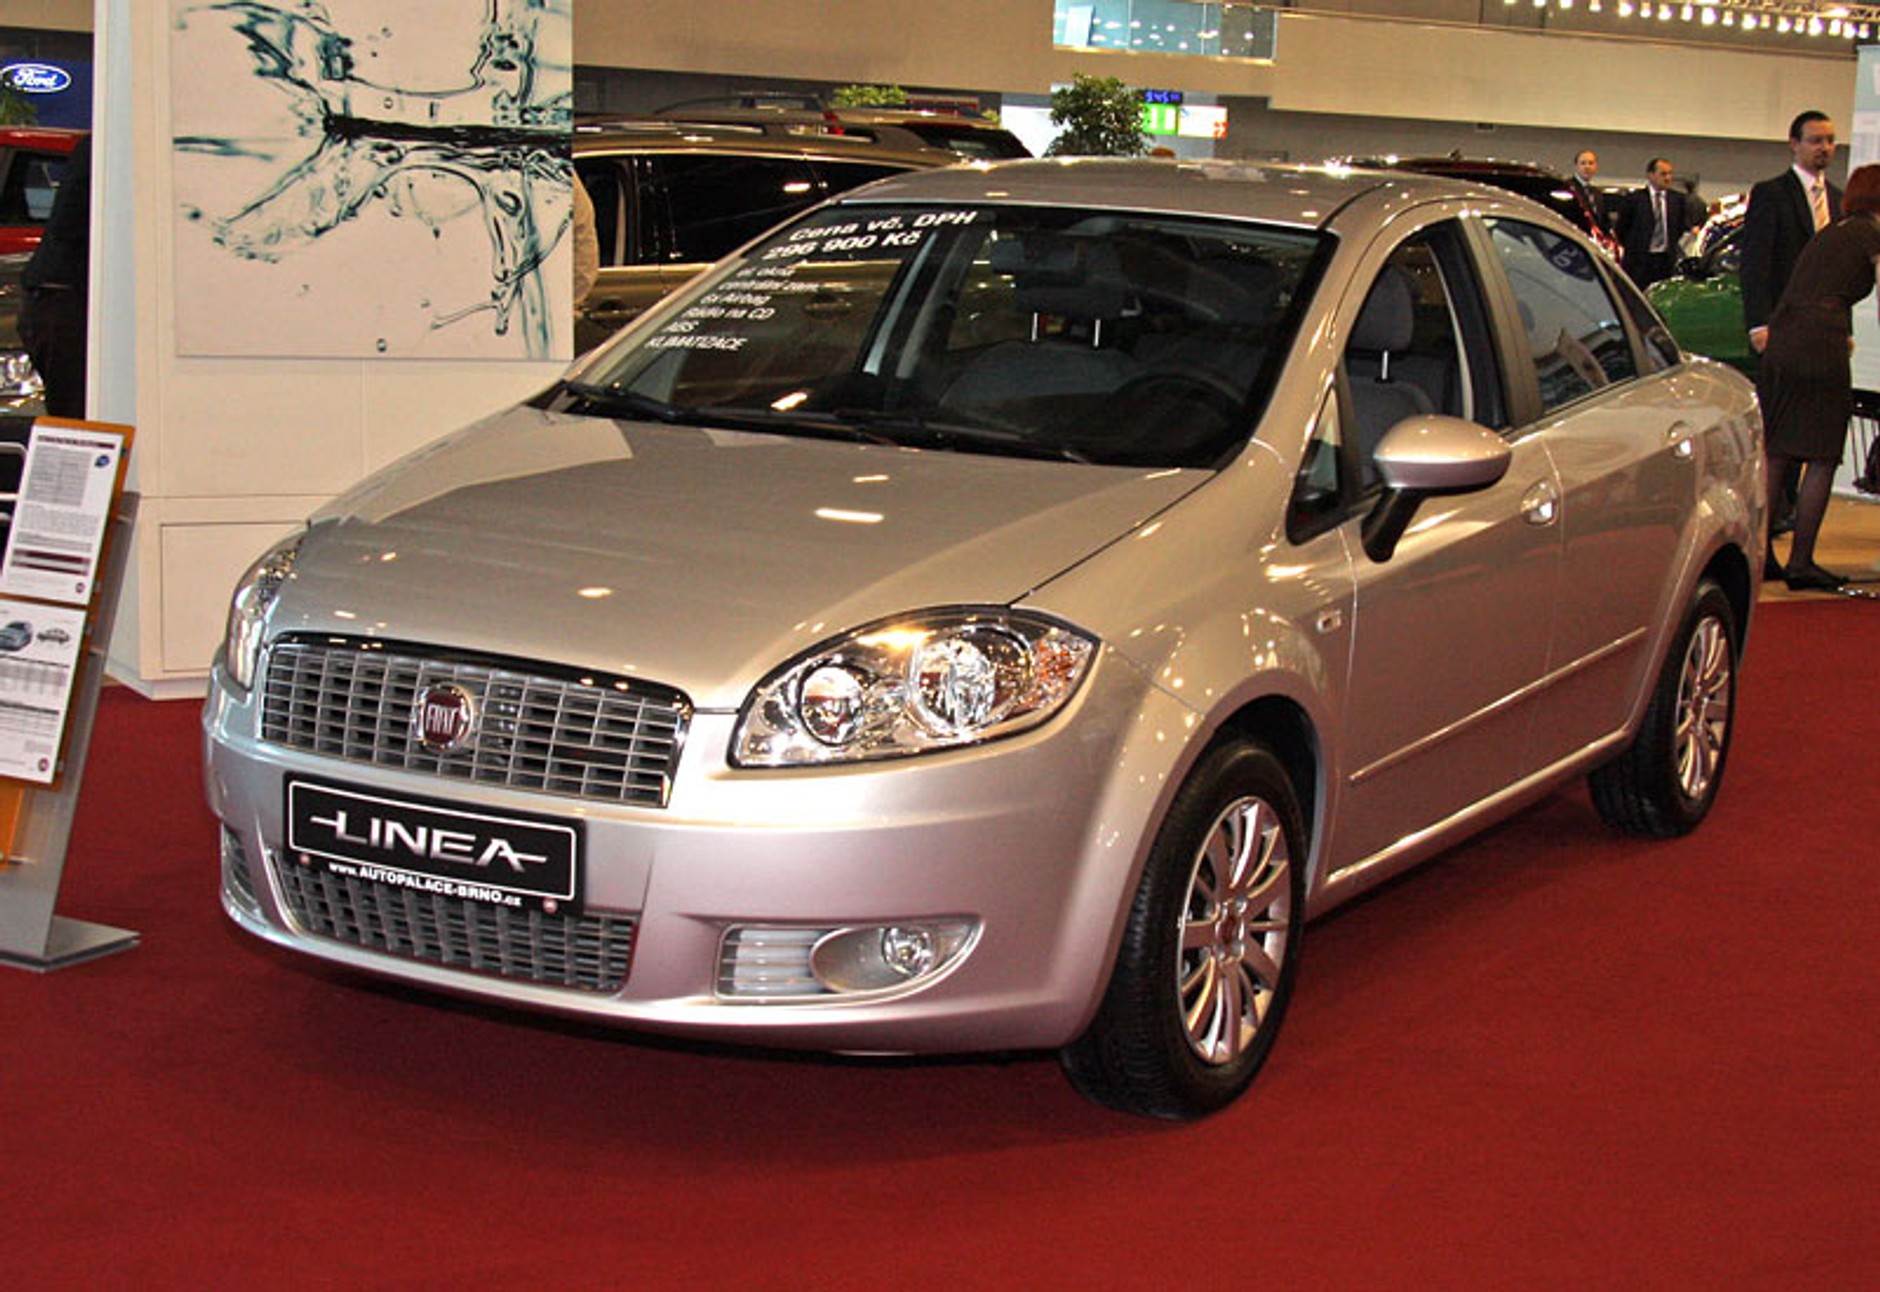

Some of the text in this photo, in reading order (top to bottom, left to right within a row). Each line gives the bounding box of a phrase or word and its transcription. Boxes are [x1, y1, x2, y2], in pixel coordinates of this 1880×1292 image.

[13, 69, 58, 87] Ford
[789, 223, 859, 241] Cena
[913, 211, 978, 227] DPH
[822, 234, 877, 252] 900
[881, 230, 922, 246] Kč
[747, 307, 776, 321] CD
[425, 702, 460, 735] FIAT
[310, 810, 547, 873] LINEA
